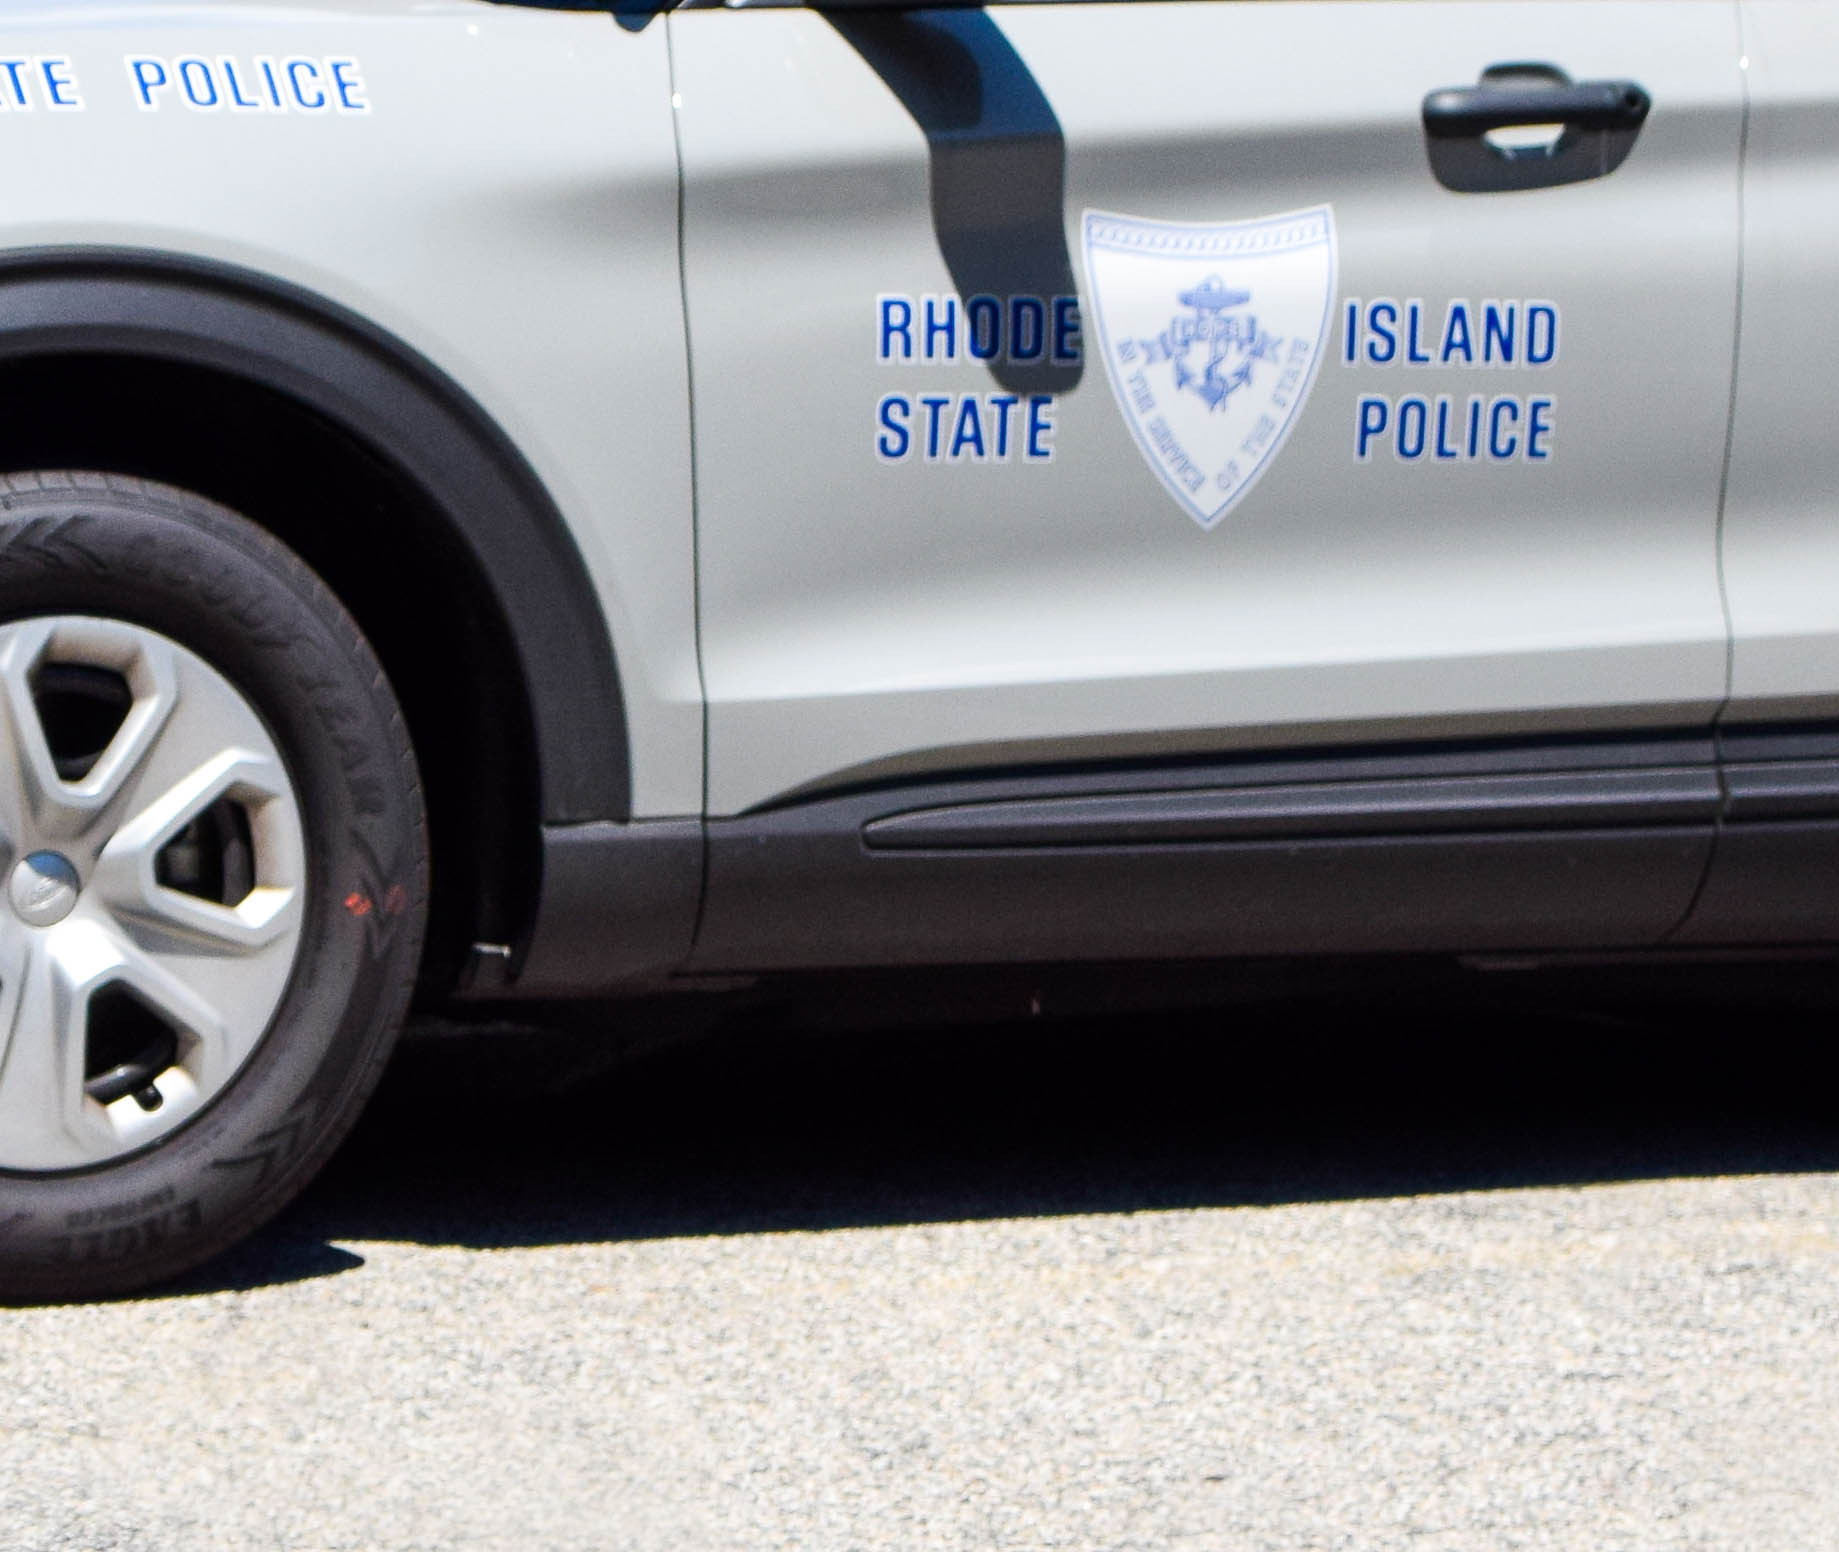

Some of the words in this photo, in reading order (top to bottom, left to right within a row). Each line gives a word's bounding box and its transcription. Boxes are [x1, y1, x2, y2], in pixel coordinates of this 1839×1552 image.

[132, 60, 363, 109] POLICE
[879, 296, 1081, 362] RHODE
[1345, 302, 1557, 364] ISLAND
[879, 395, 1054, 458] STATE
[1357, 399, 1552, 459] POLICE
